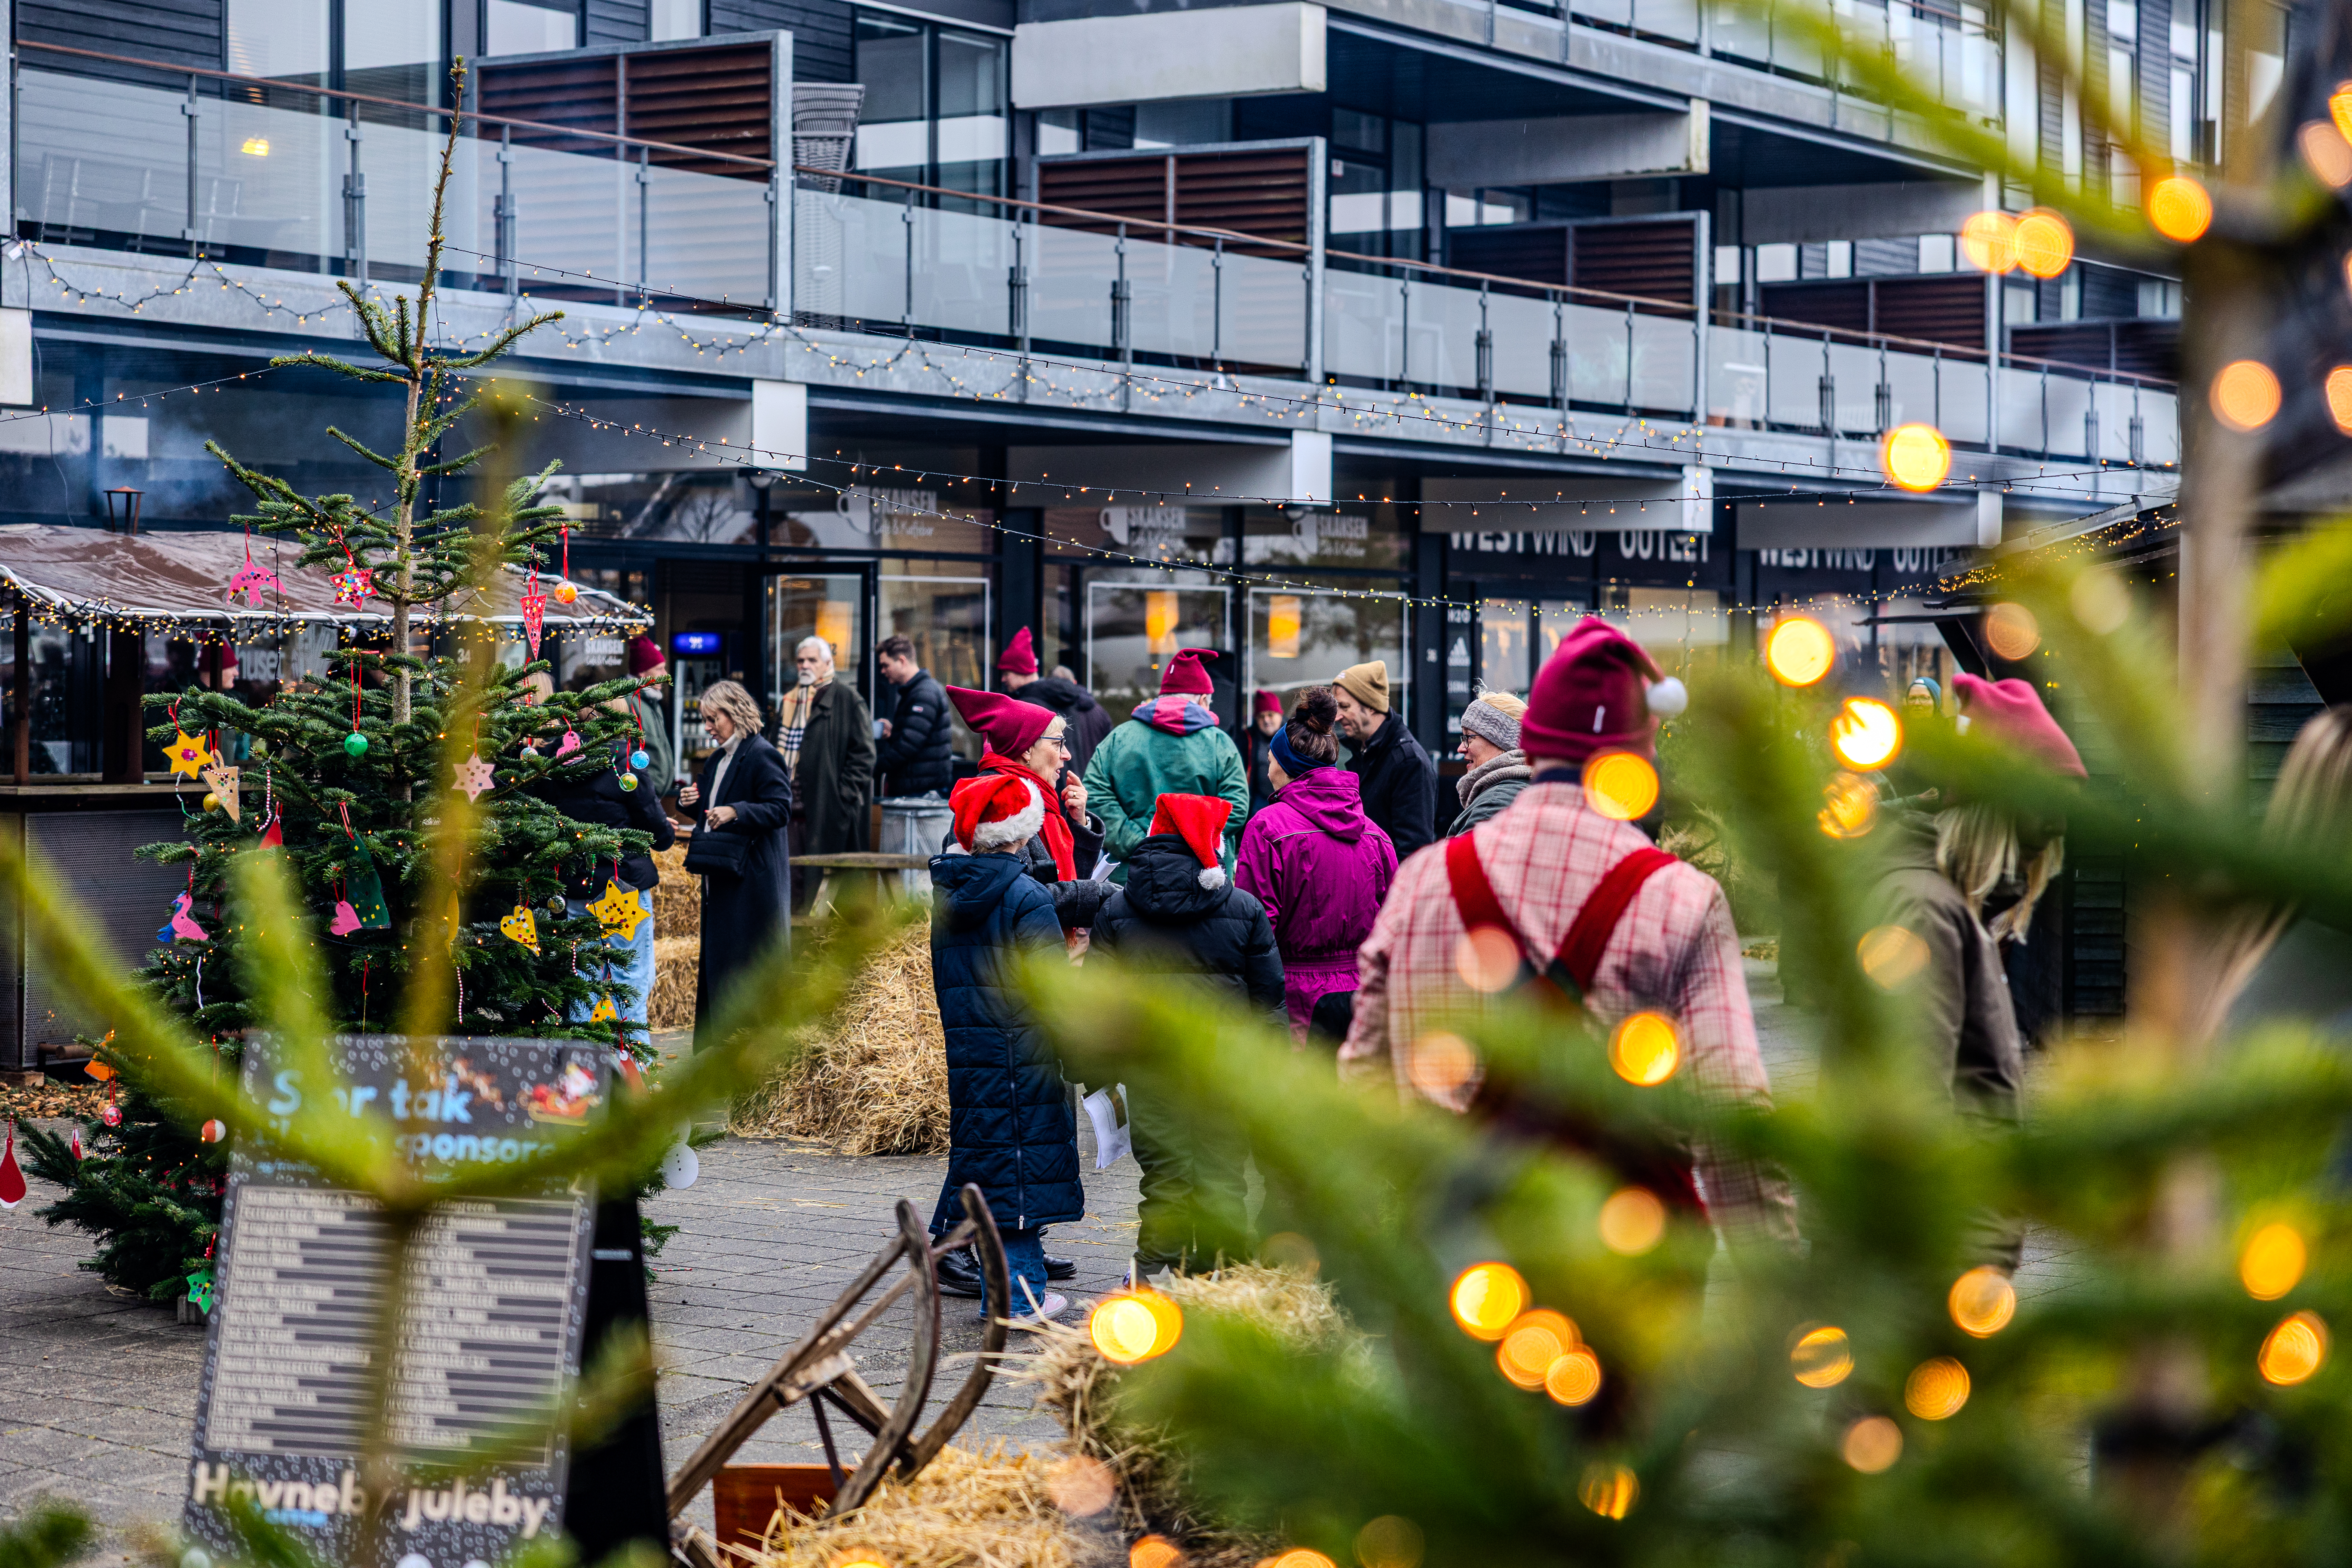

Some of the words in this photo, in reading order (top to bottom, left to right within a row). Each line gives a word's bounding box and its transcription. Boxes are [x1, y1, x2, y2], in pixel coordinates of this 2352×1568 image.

[871, 487, 937, 517] SKANSEN
[457, 647, 471, 663] 34
[585, 639, 624, 654] SKANSEN
[389, 1072, 474, 1124] tak
[399, 1476, 551, 1540] juleby
